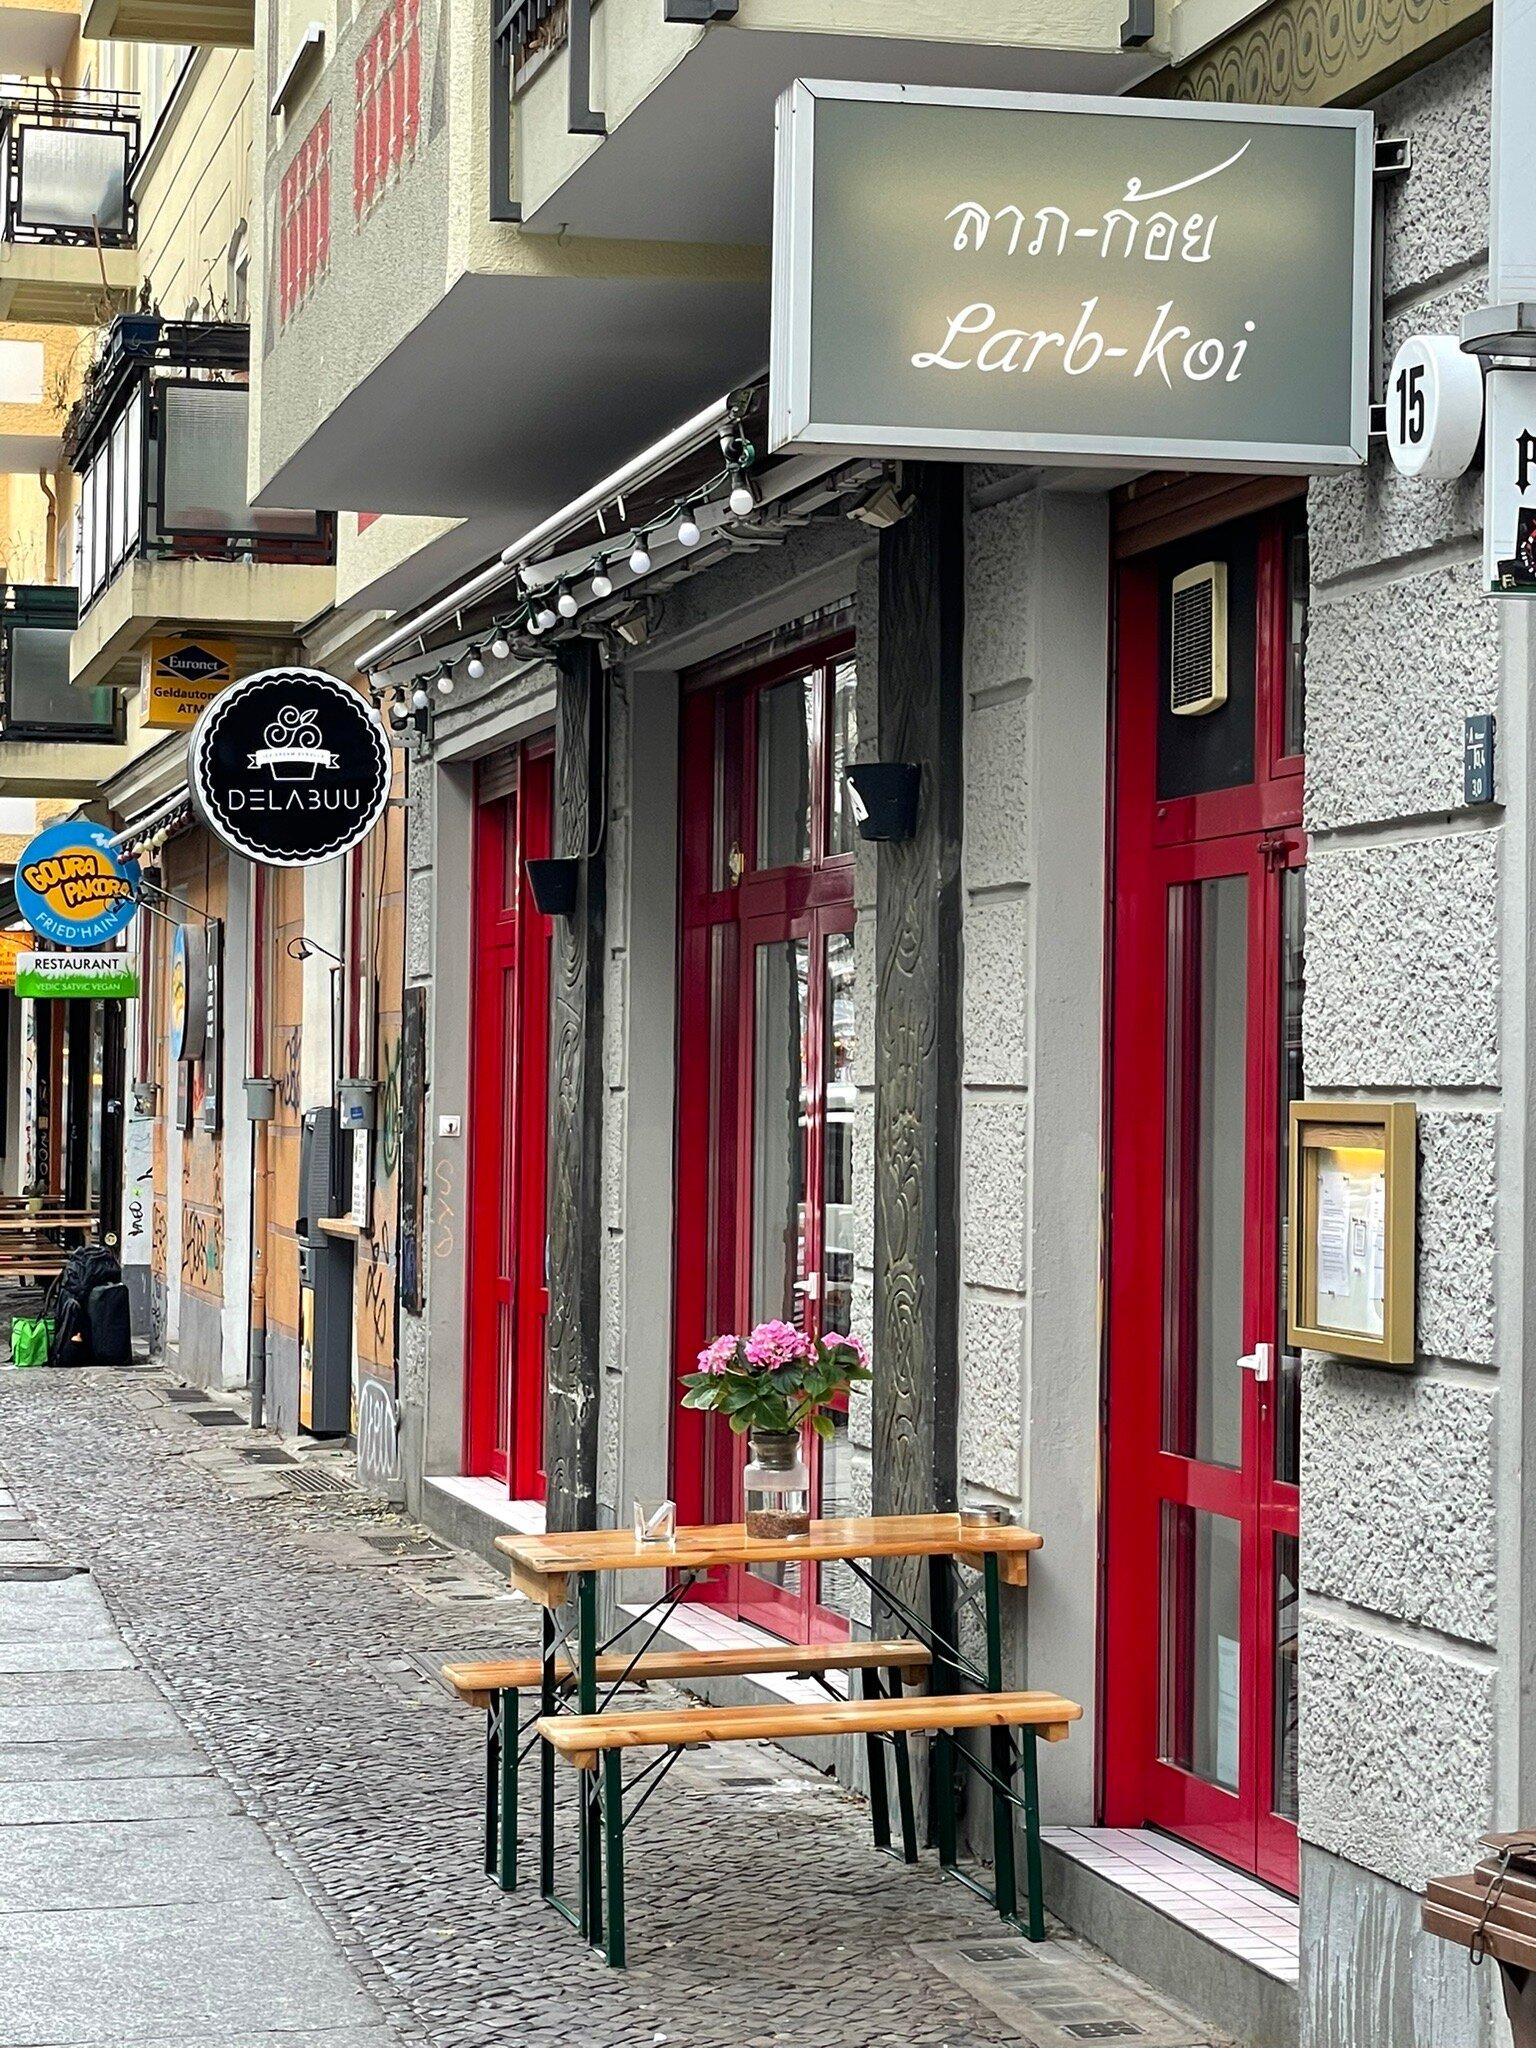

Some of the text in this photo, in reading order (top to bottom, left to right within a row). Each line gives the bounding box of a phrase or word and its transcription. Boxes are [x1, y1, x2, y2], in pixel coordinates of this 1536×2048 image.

[1396, 364, 1425, 445] 15
[169, 656, 218, 670] Euronet
[228, 789, 360, 811] DELABUU
[22, 855, 97, 893] GOURA
[63, 876, 131, 907] PAKORA
[35, 911, 119, 939] FRIED'HAIN
[34, 957, 120, 970] RESTAURANT
[36, 982, 60, 991] VEDIC
[93, 982, 121, 991] VEGAN
